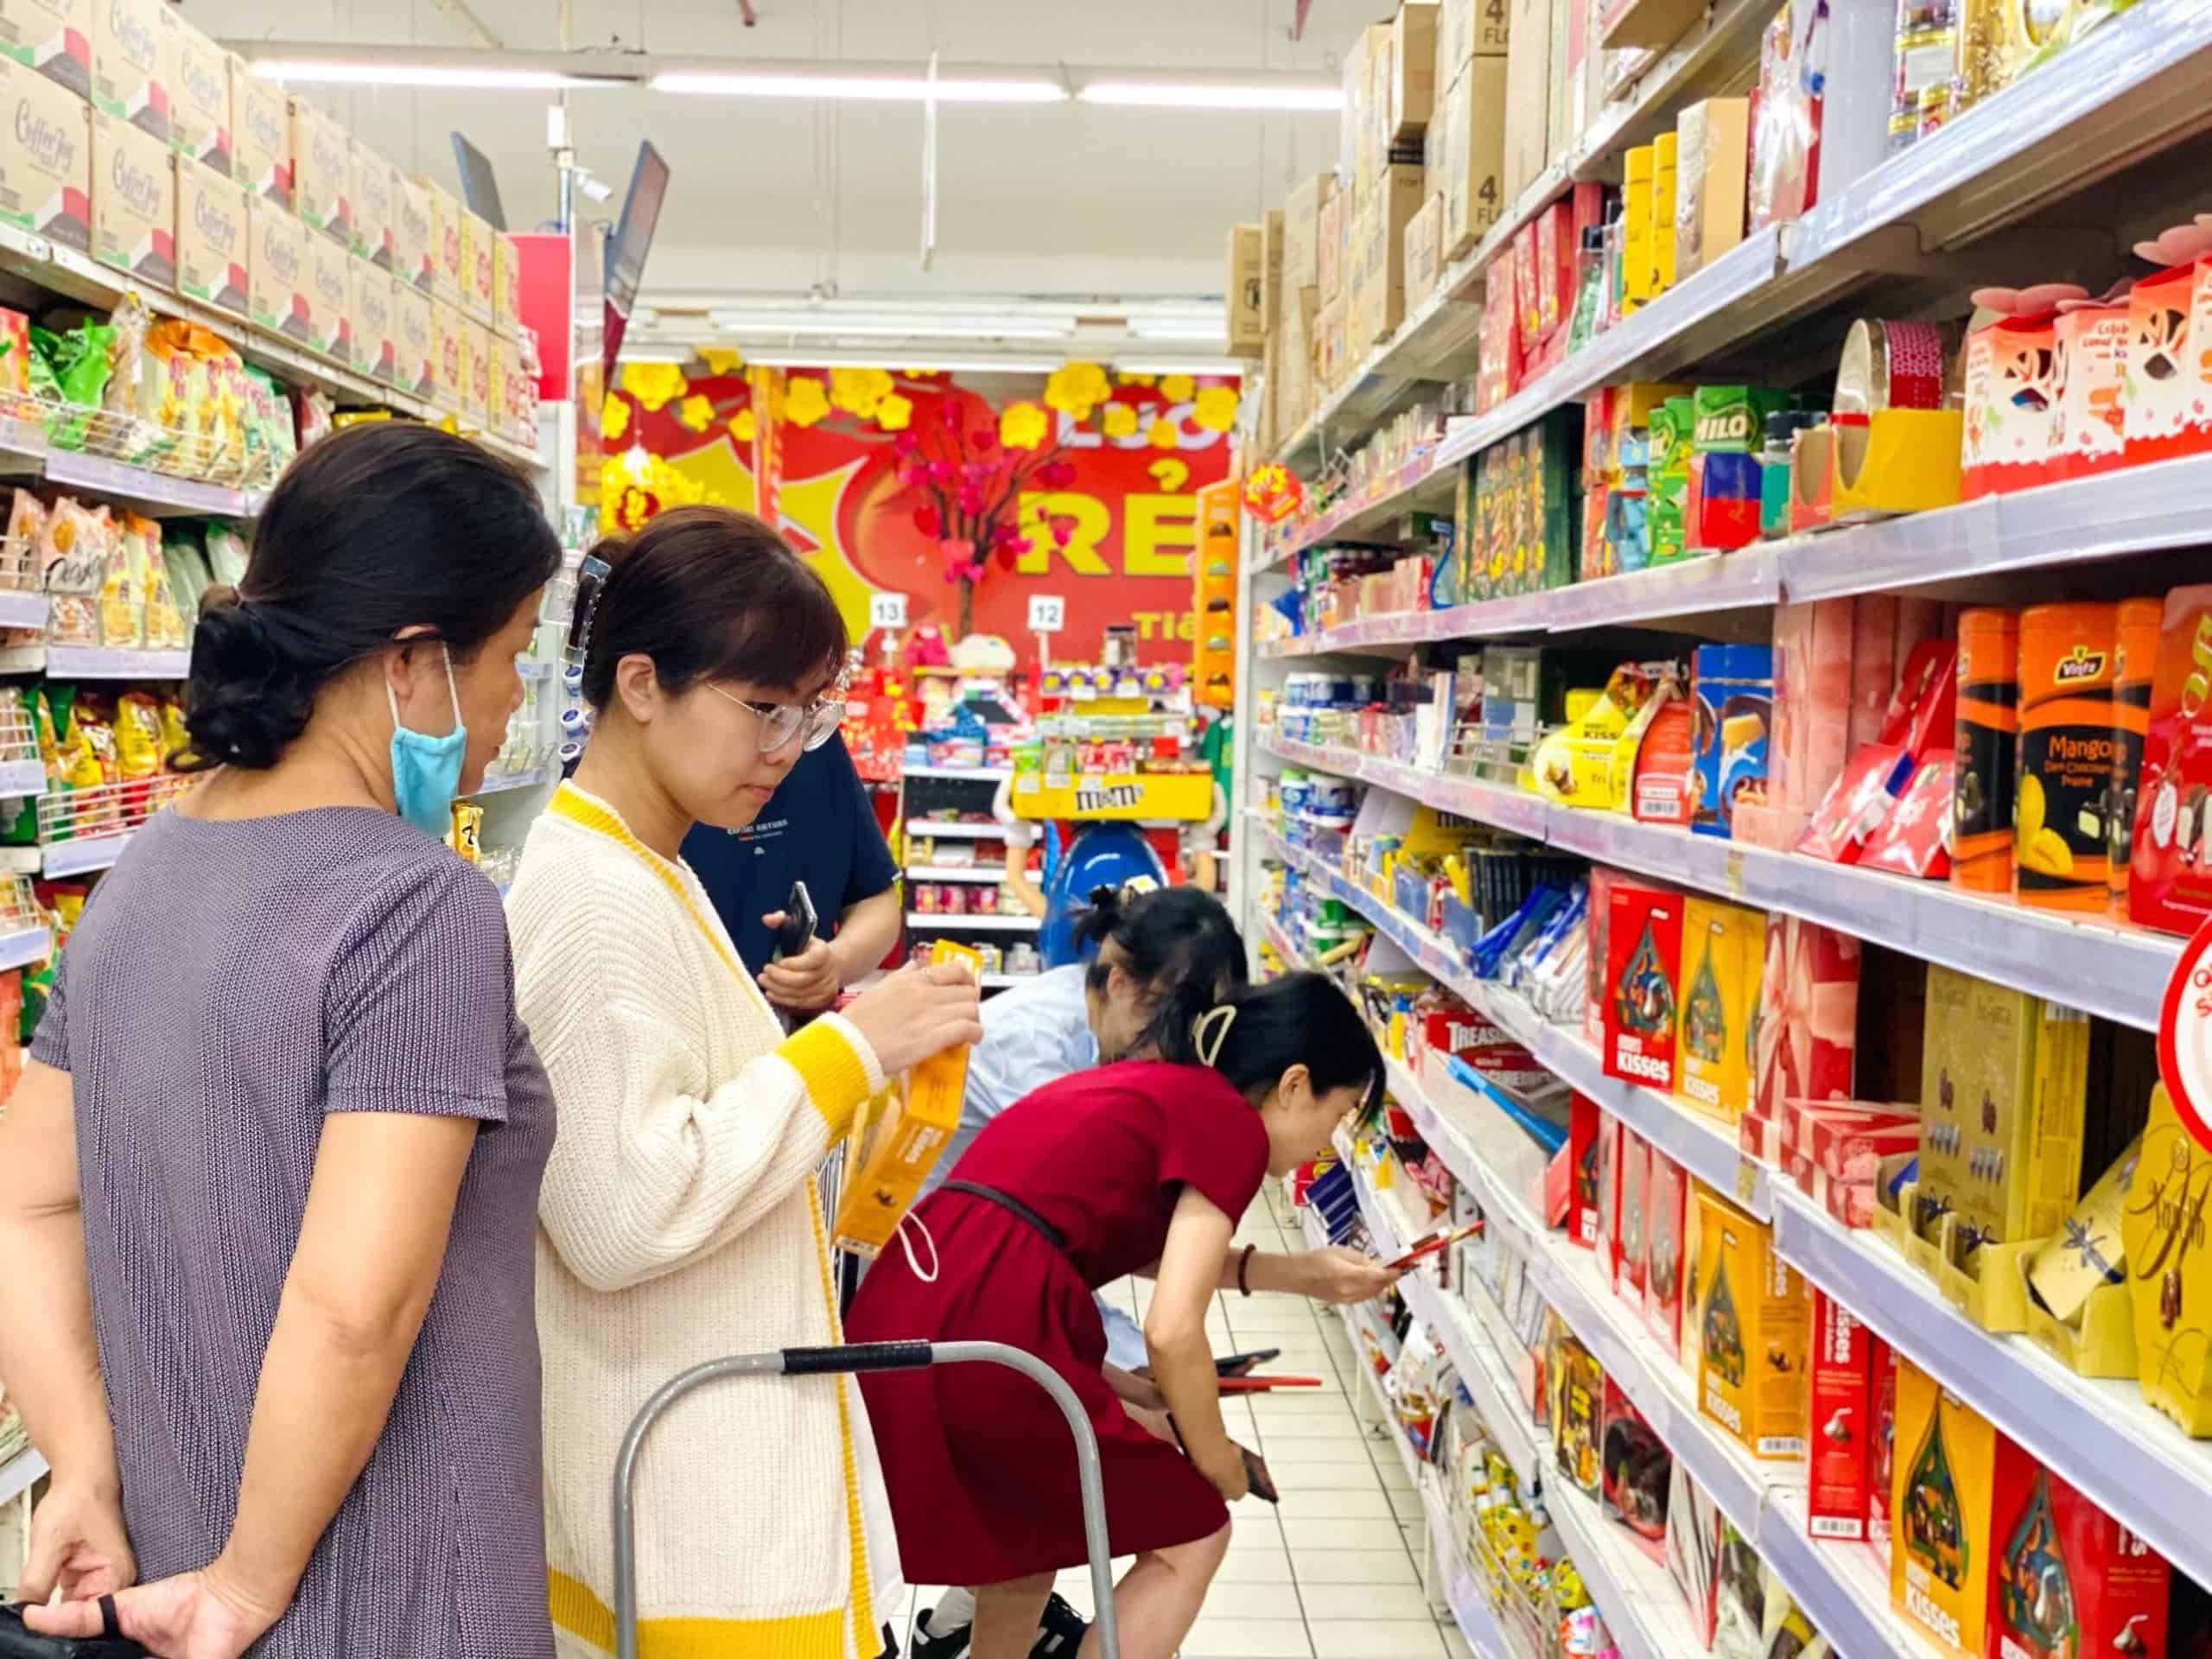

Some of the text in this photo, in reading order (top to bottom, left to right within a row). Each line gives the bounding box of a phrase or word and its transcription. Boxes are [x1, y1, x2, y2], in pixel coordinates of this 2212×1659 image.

[1486, 0, 1504, 24] 4
[1478, 175, 1497, 205] 4
[876, 601, 899, 621] 13
[1036, 605, 1059, 623] 12
[2049, 734, 2111, 761] Mango
